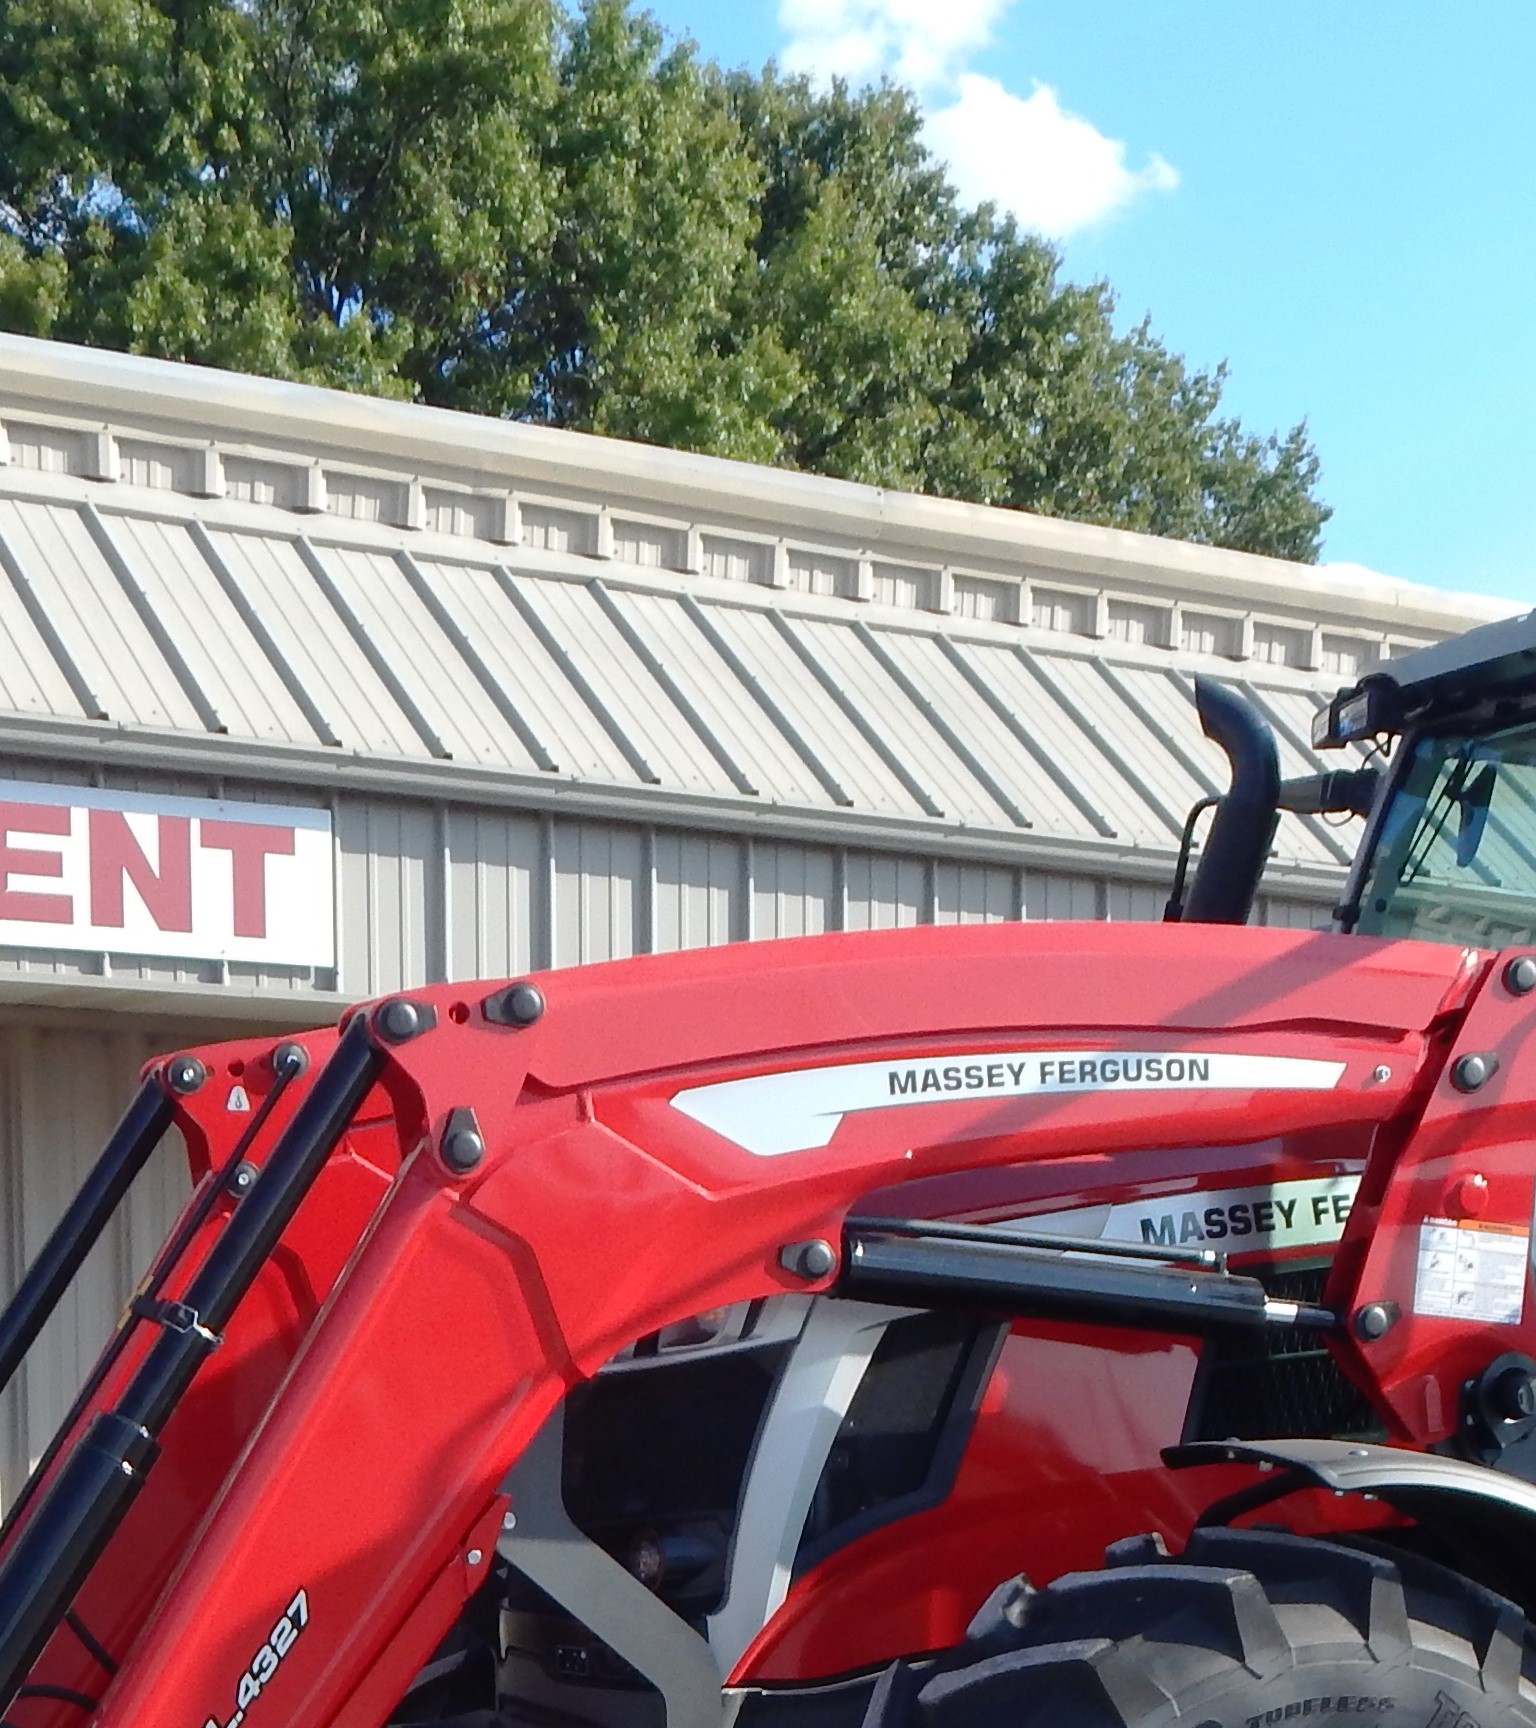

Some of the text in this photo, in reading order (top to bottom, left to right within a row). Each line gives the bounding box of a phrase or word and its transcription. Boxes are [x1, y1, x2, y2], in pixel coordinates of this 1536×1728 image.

[888, 1057, 1210, 1096] MASSEY FERGUSON
[1139, 1198, 1298, 1246] MASSEY
